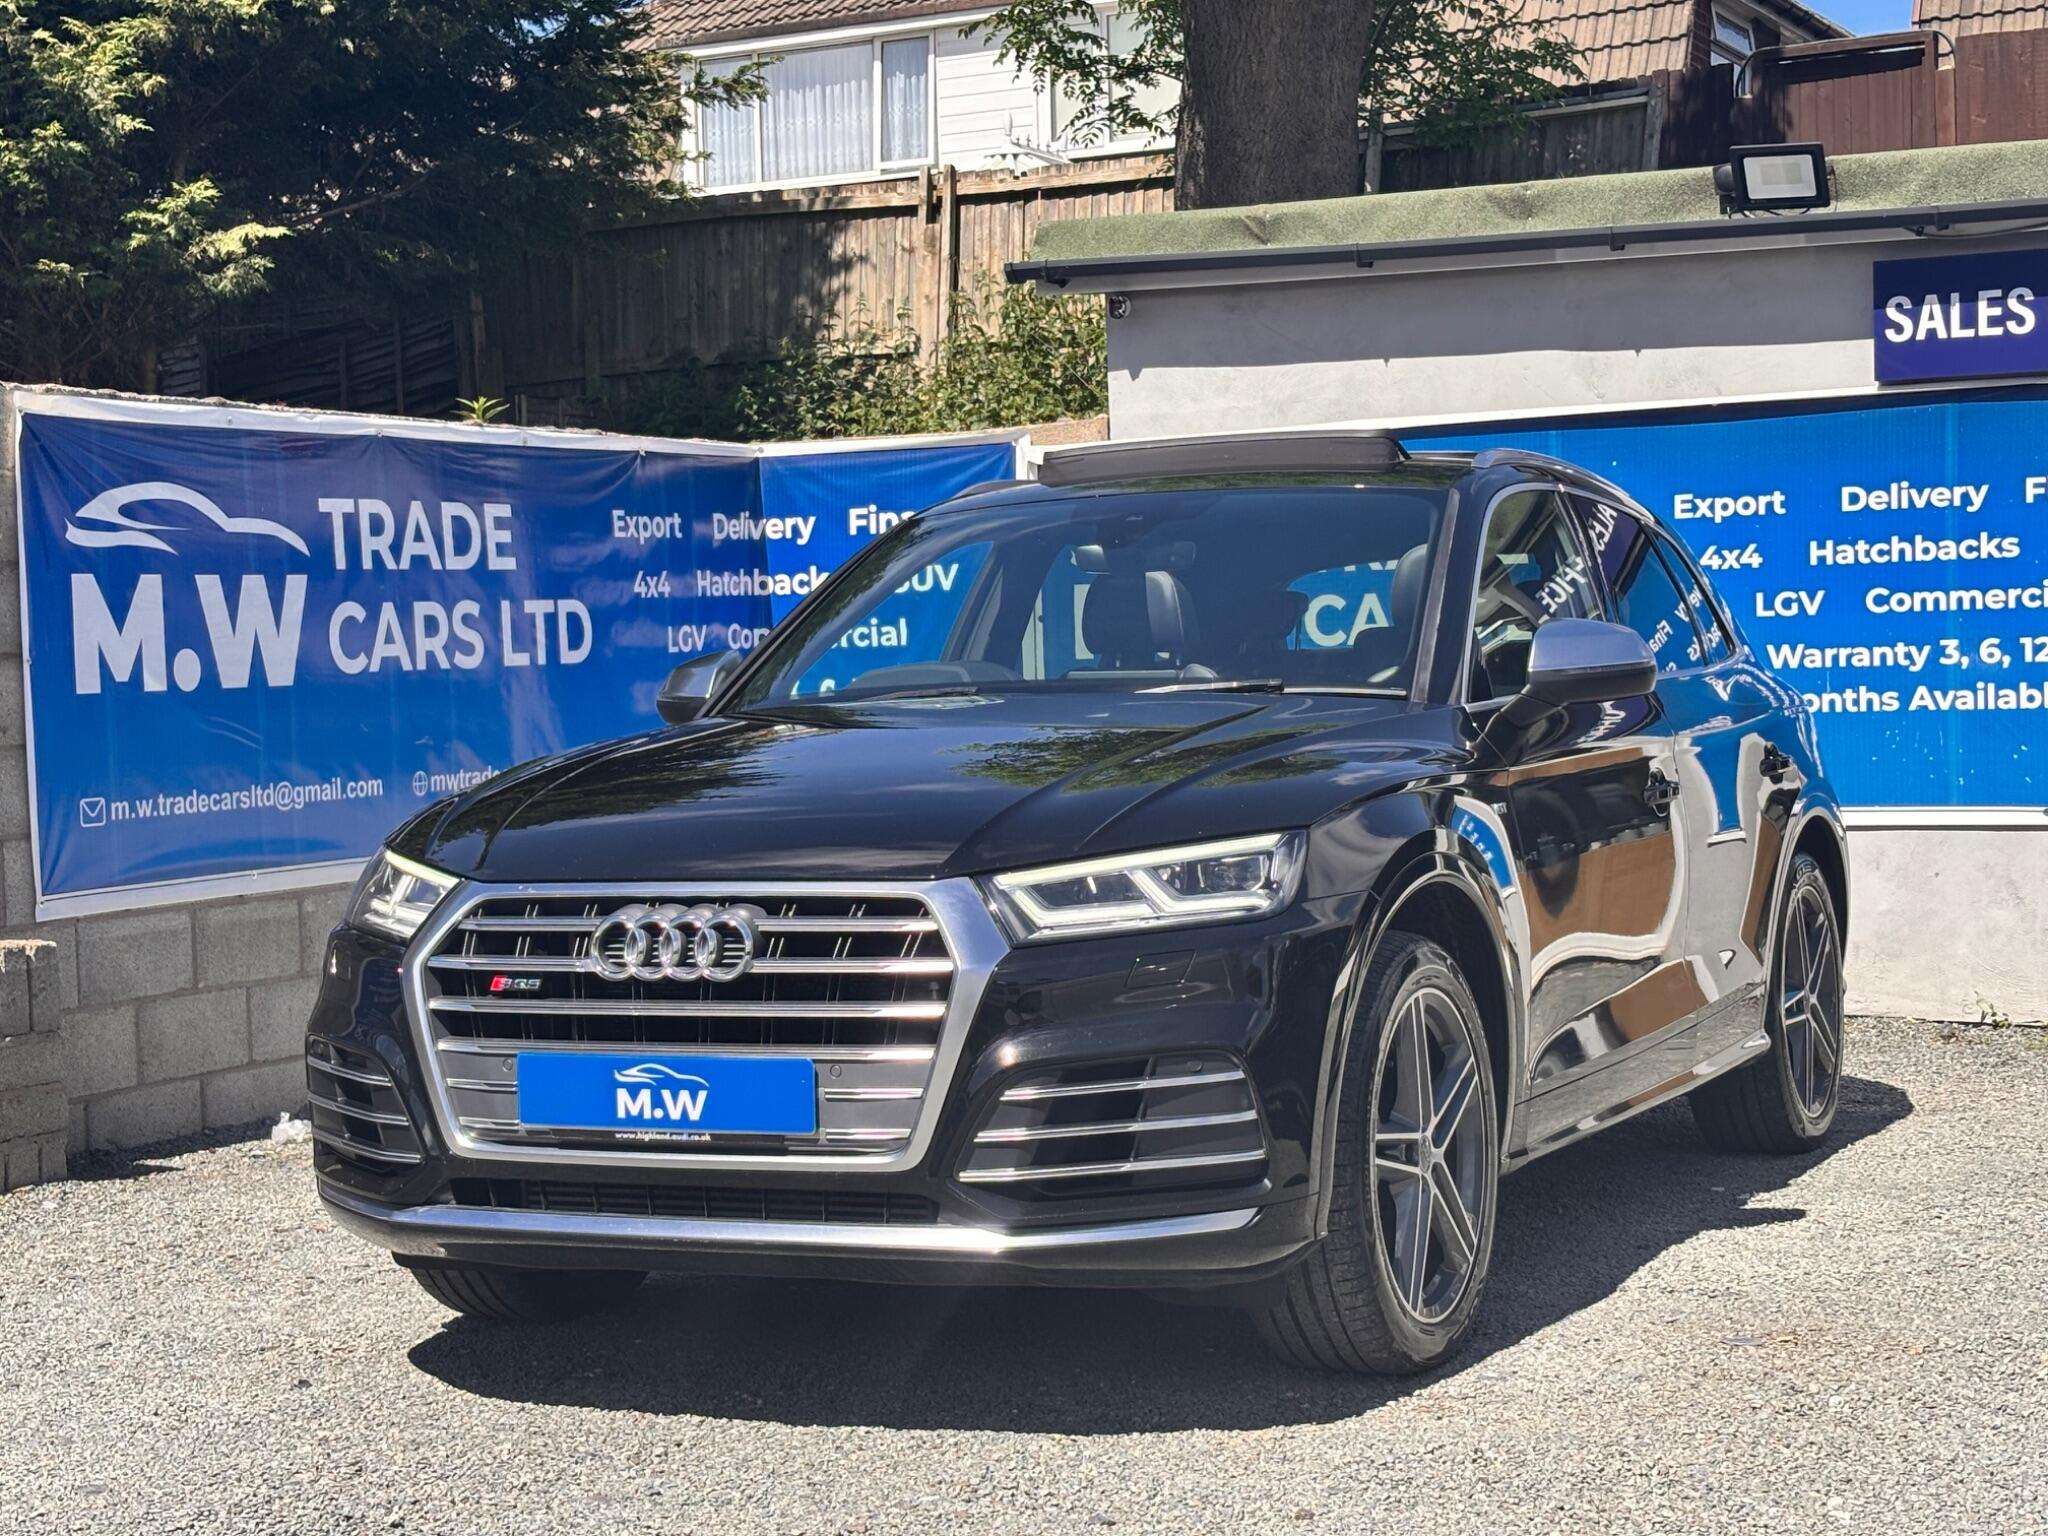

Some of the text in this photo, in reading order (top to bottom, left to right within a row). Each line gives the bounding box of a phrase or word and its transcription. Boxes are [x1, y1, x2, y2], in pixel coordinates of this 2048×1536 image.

[1884, 287, 2036, 342] SALES
[1674, 490, 1786, 524] Export
[1841, 481, 1989, 513] Delivery
[318, 497, 517, 571] TRADE
[612, 509, 682, 544] Export
[712, 511, 816, 545] Delivery
[1700, 531, 2021, 571] 4x4 Hatchbacks
[633, 569, 671, 599] 4x4
[1756, 589, 1825, 618] LGV
[71, 573, 309, 694] M.W
[329, 598, 593, 675] CARS LTD
[667, 623, 708, 653] LGV
[1766, 636, 2048, 673] Warranty 3, 6, 12
[111, 777, 384, 821] m.w.tradecarsltd@gmail.com
[616, 1086, 708, 1121] M.W
